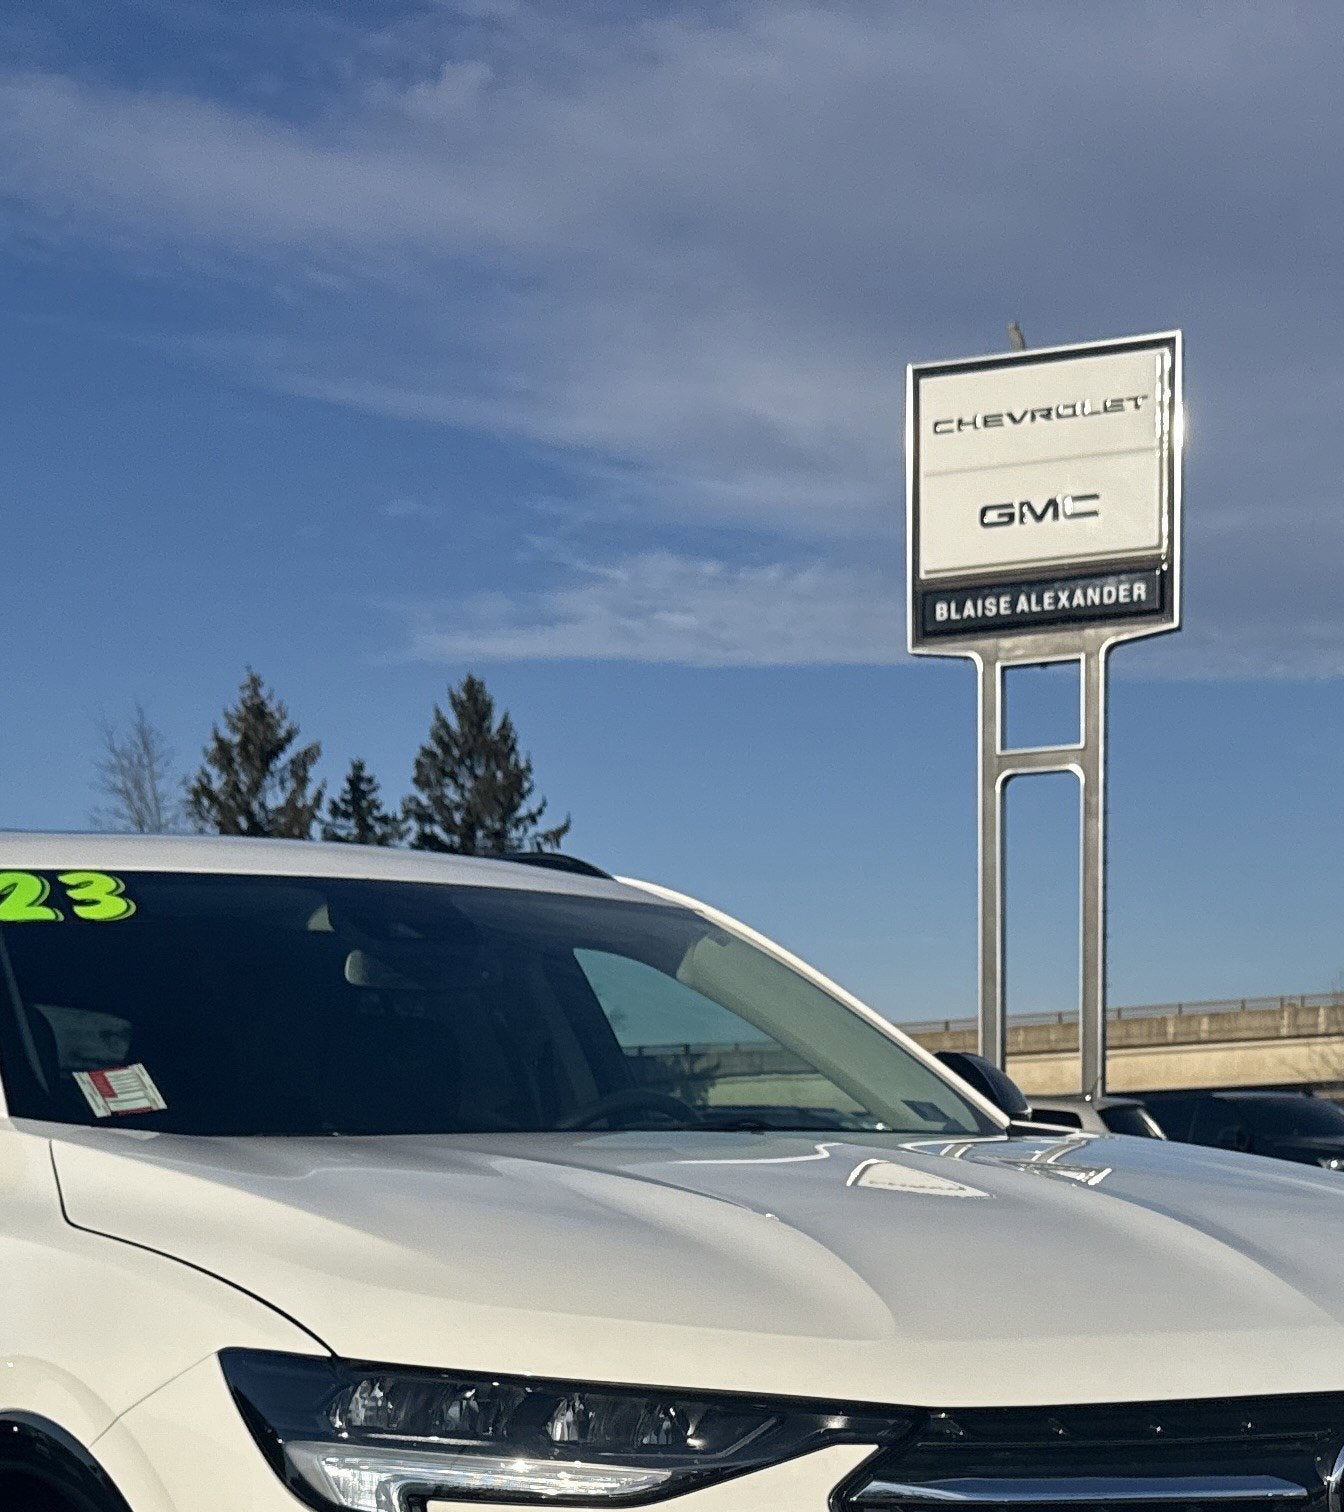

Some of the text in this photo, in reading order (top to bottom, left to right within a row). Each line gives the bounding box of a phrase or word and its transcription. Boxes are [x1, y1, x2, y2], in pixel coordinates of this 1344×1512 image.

[932, 394, 1148, 434] CHEVROLET
[979, 493, 1100, 529] GMC
[934, 580, 1147, 622] BLAISE ALEXANDER
